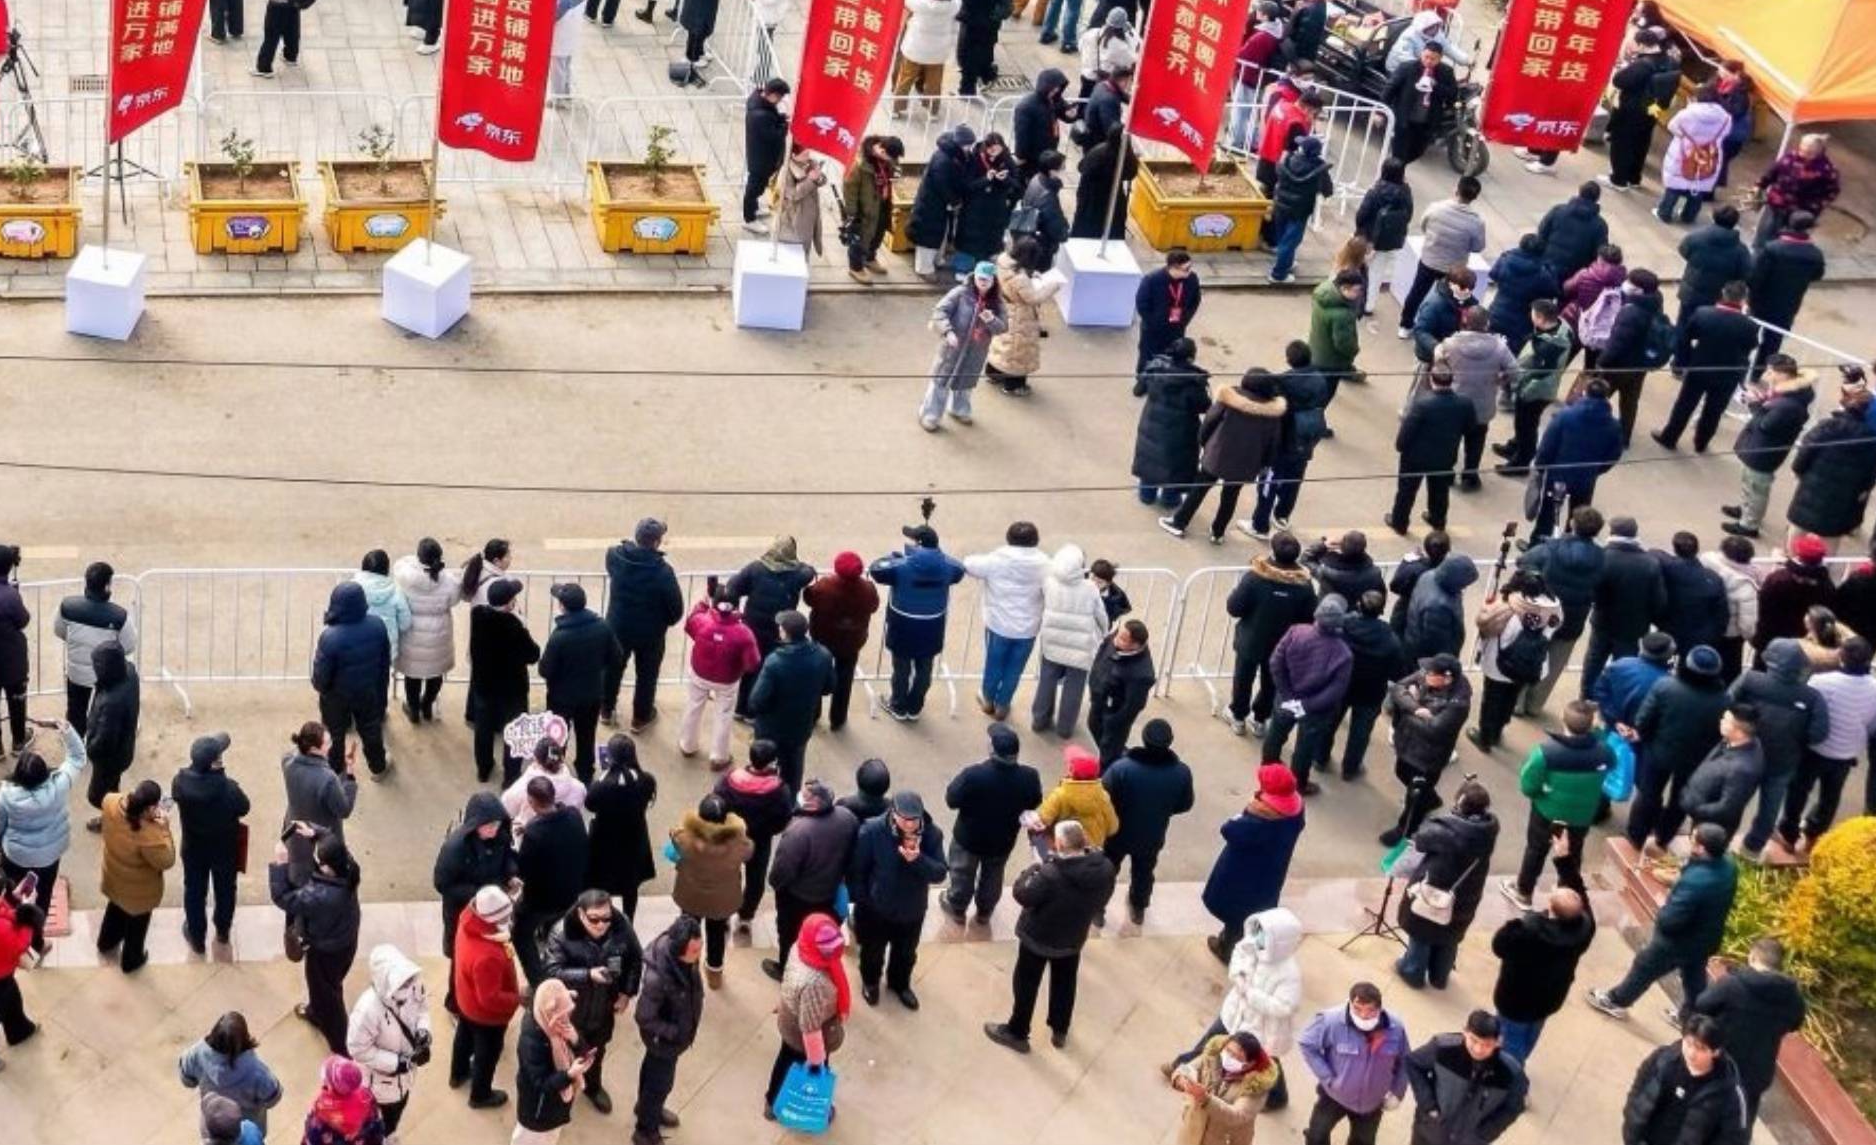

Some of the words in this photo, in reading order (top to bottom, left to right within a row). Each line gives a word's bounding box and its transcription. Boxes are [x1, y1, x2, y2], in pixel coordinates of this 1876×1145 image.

[485, 123, 522, 146] 京东
[1178, 121, 1204, 151] 京东
[1536, 119, 1578, 137] 京东
